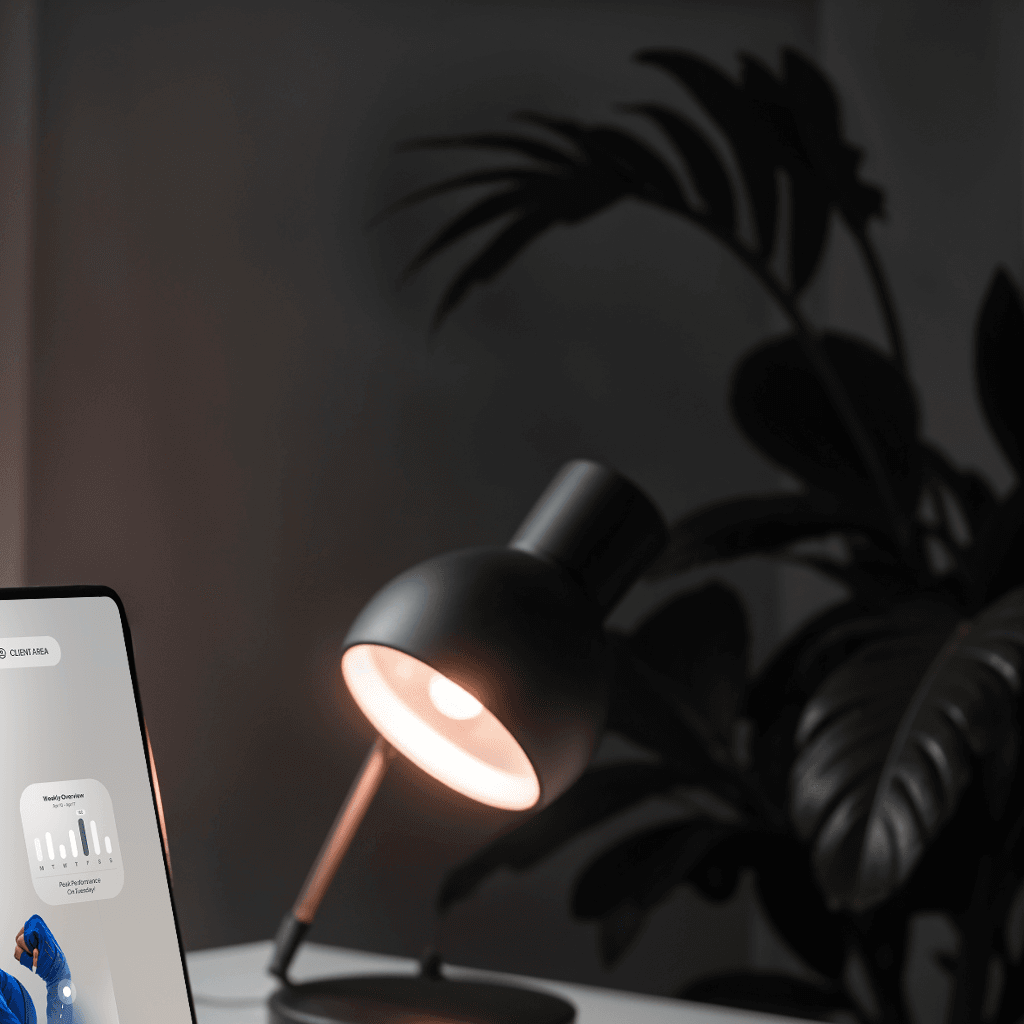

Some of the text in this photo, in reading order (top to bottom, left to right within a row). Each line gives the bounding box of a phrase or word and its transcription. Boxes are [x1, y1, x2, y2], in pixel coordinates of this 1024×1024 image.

[10, 647, 49, 657] CLIENT AREA
[71, 878, 101, 886] Performance
